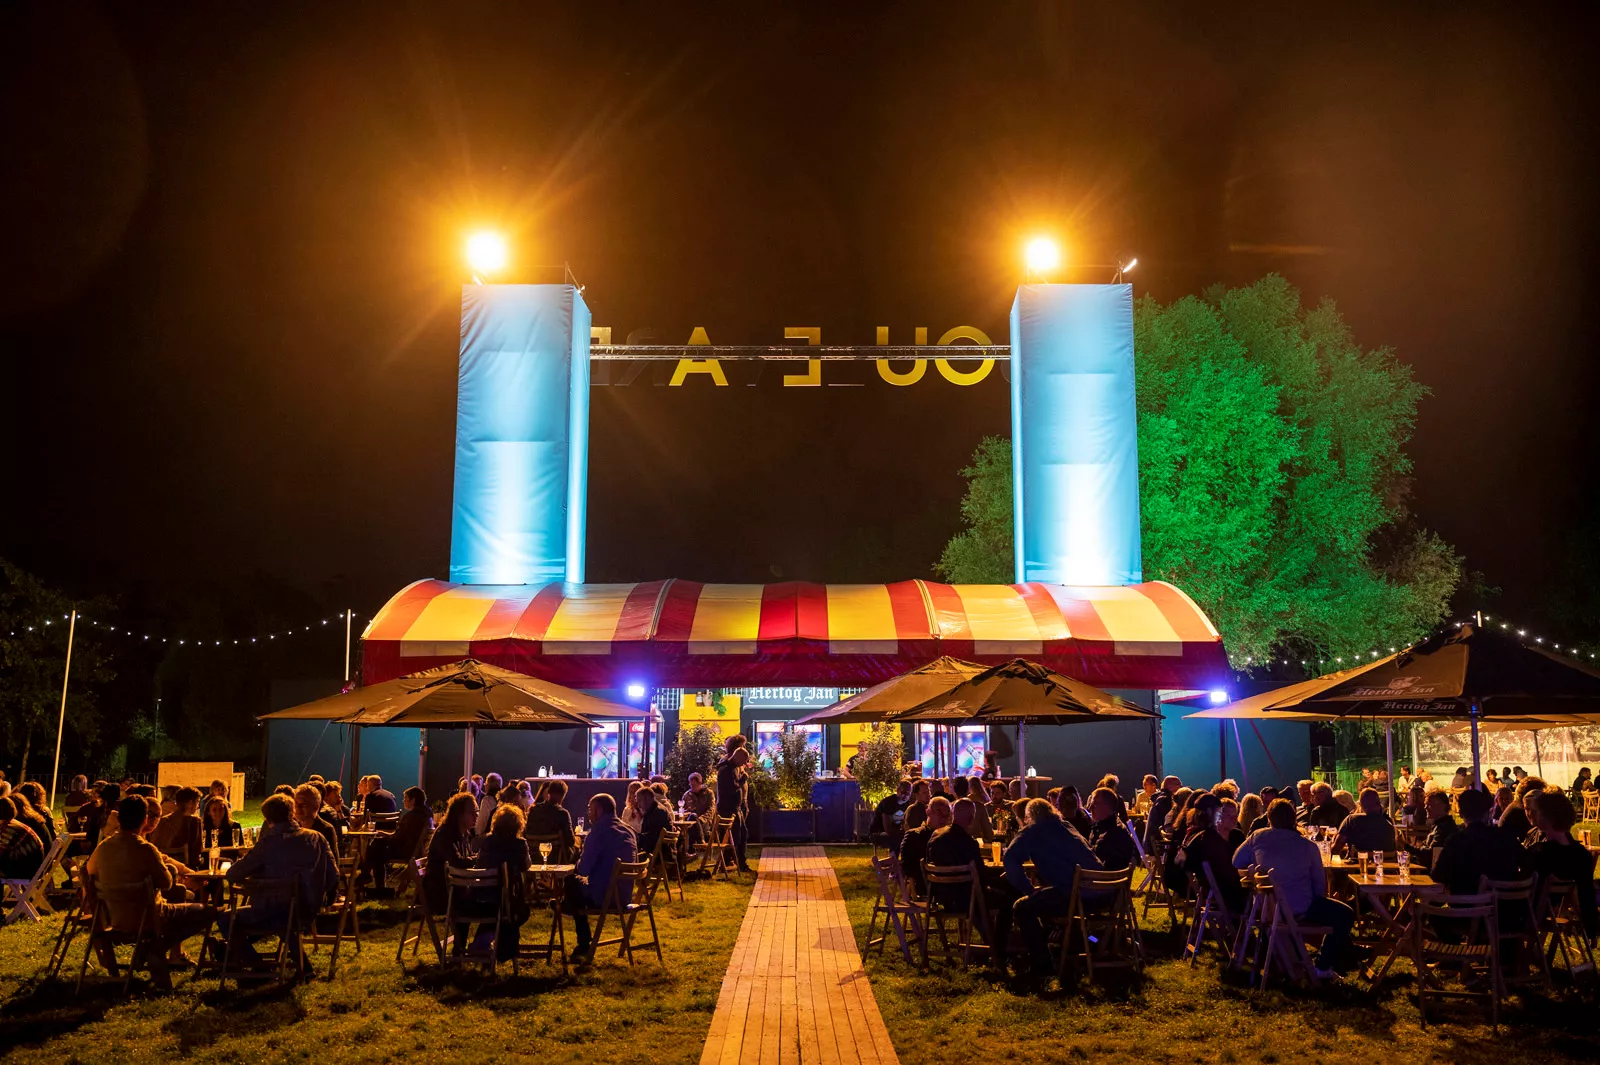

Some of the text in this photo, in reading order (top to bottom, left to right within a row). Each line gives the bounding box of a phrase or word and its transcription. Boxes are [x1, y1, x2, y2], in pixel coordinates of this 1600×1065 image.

[748, 687, 802, 704] Hertog
[803, 687, 834, 704] Jan
[1380, 701, 1457, 711] Hertog Jan
